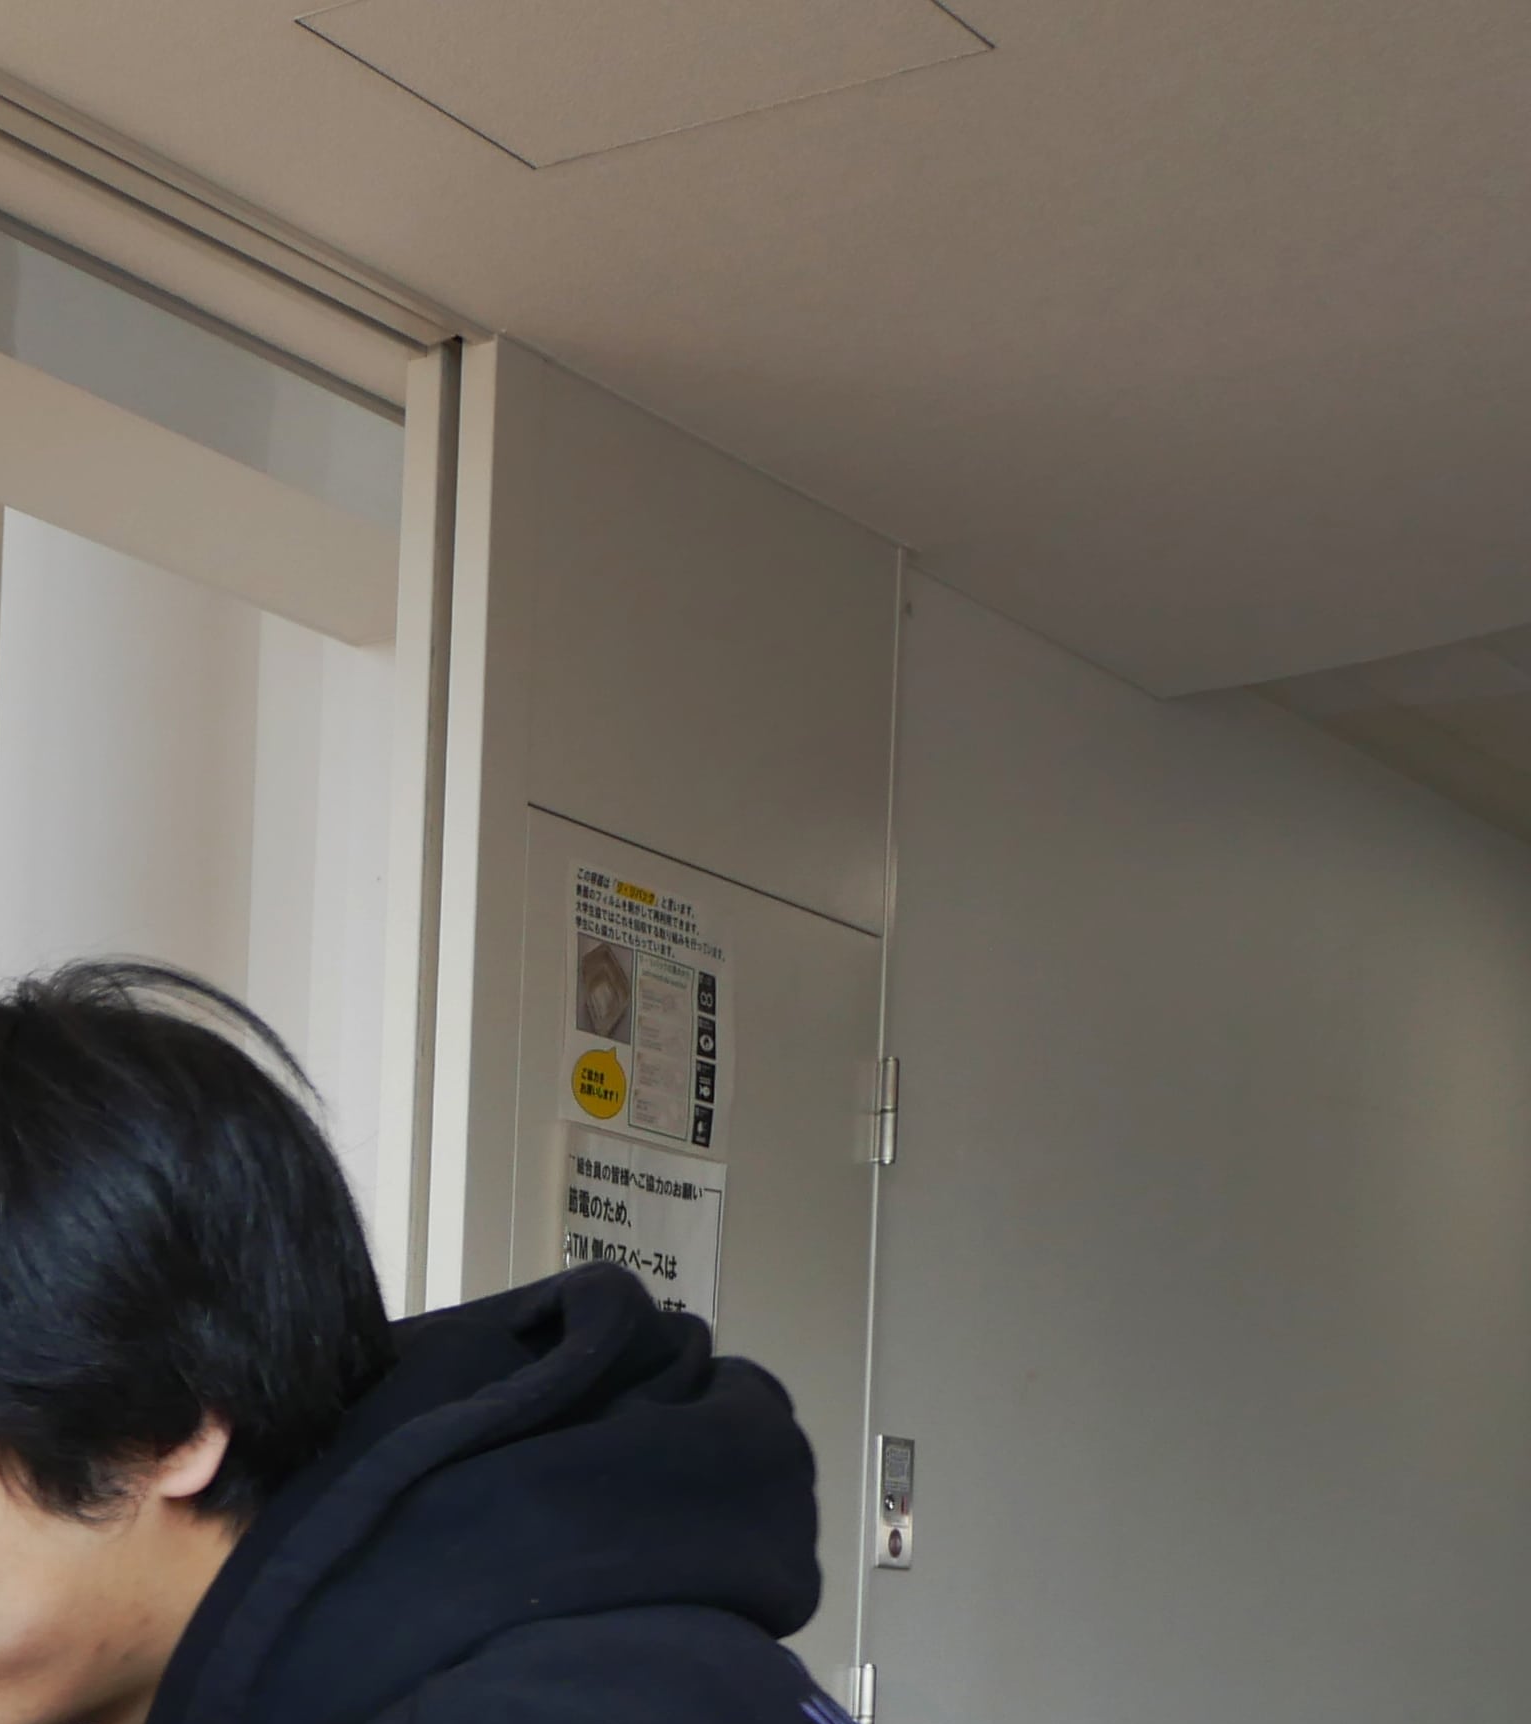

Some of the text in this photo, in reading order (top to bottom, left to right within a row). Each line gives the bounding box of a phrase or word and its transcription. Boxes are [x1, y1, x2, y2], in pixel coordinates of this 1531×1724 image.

[577, 1156, 703, 1200] 組合員の皆様へご協力のお願い
